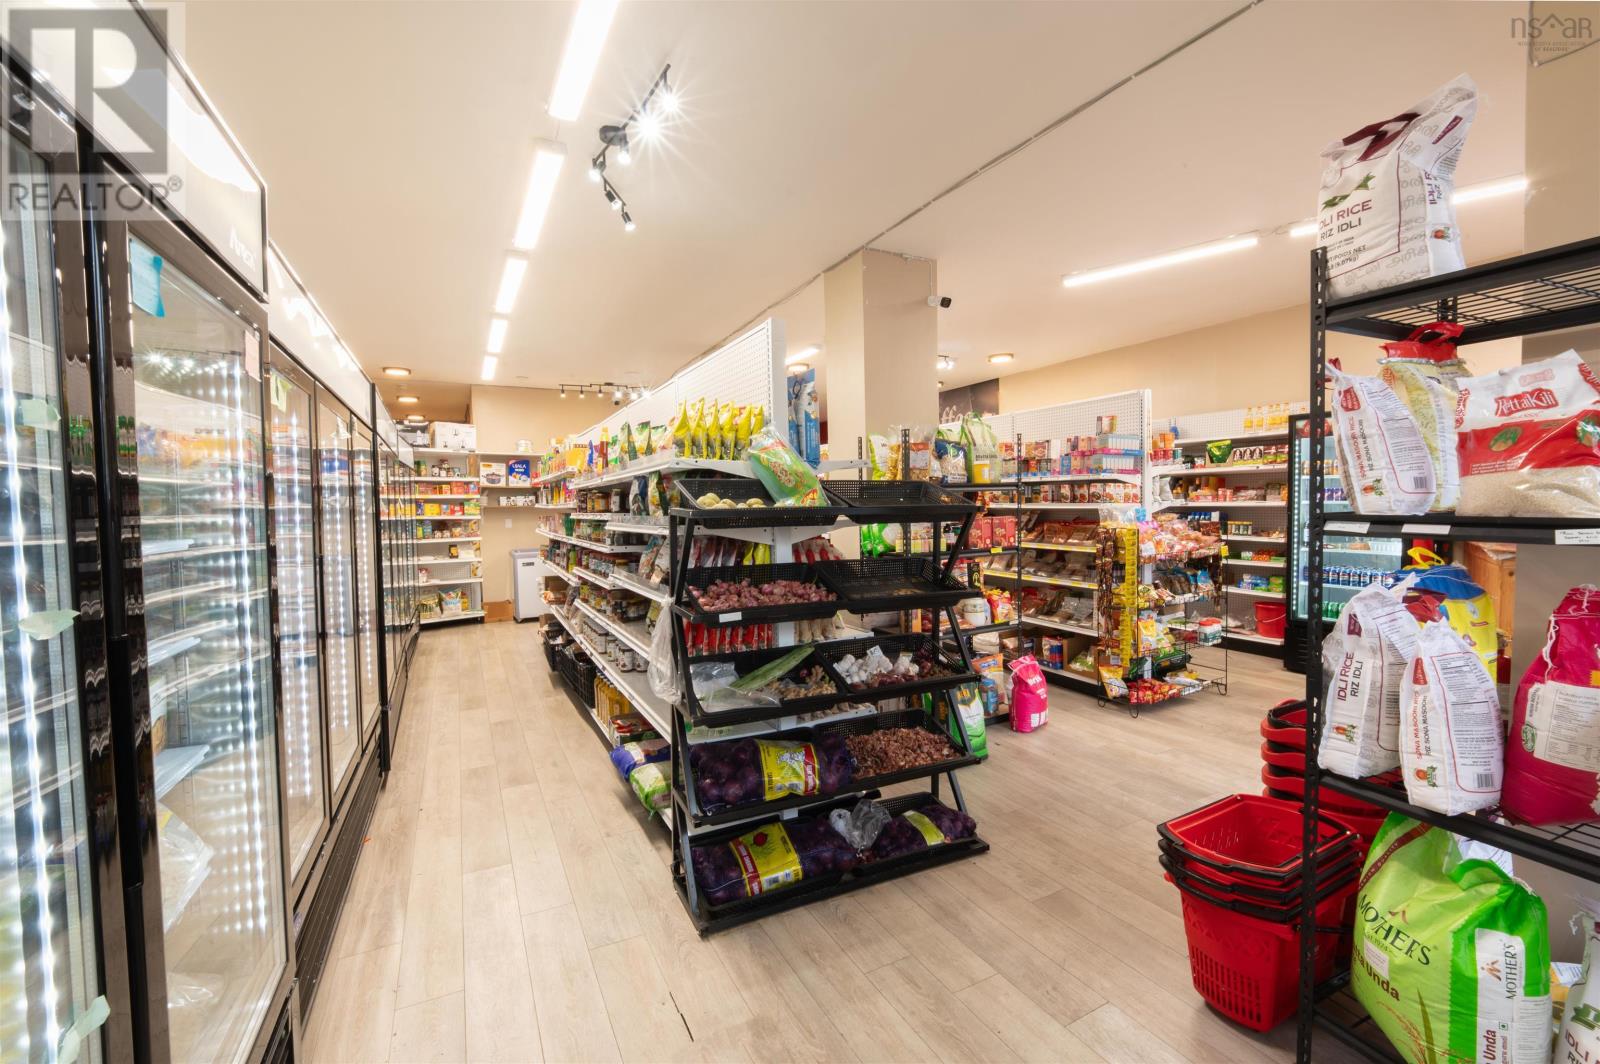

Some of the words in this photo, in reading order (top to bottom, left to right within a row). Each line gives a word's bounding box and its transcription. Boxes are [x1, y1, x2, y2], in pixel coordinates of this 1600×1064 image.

[1337, 199, 1372, 221] RICE
[1320, 228, 1335, 241] RIZ
[1337, 217, 1362, 233] IDLI
[1340, 652, 1355, 678] RICE
[1353, 661, 1364, 679] IDLI
[1337, 679, 1349, 701] IDLI
[1350, 681, 1360, 697] RIZ
[1422, 726, 1431, 744] SONA
[1483, 1029, 1497, 1061] Unda
